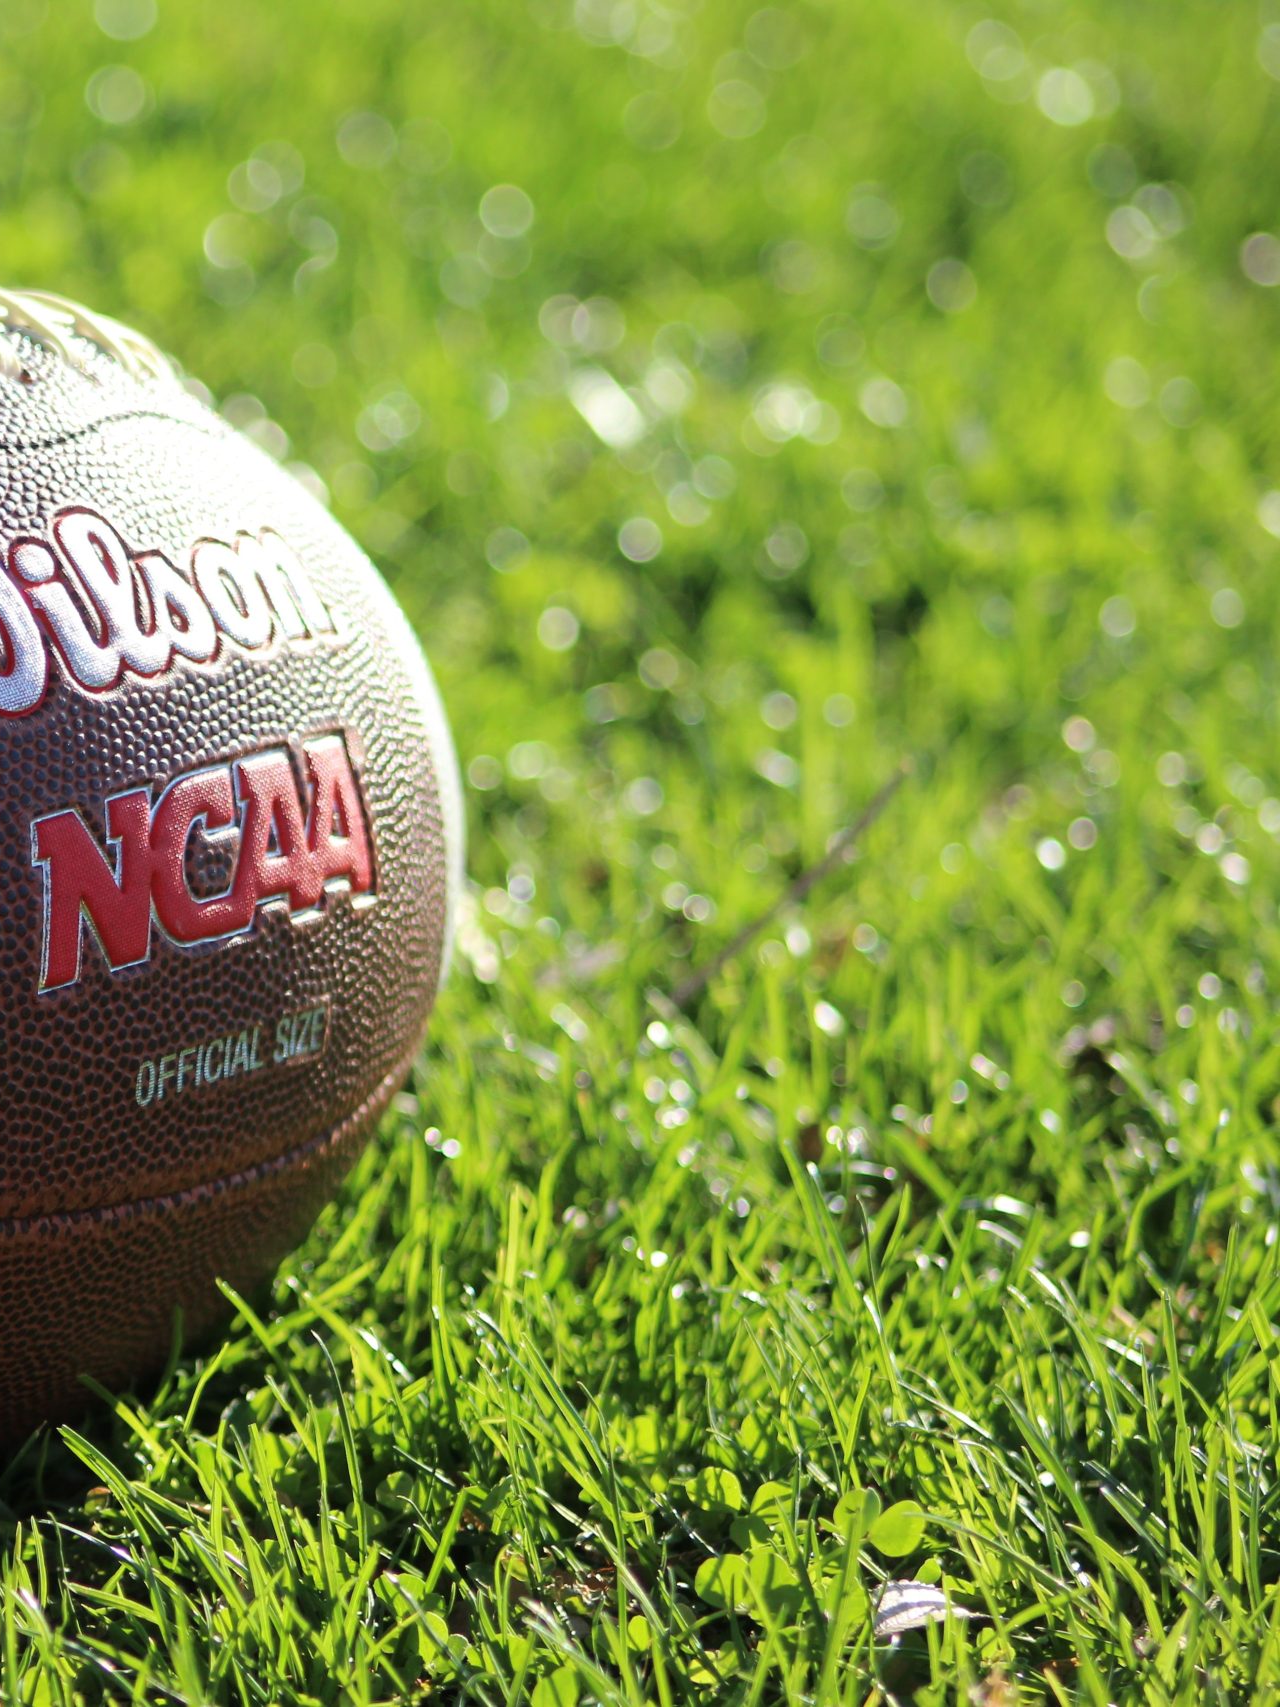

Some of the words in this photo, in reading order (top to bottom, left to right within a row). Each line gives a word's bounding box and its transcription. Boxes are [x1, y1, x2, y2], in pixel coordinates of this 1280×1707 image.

[30, 729, 377, 994] NCAA
[135, 1026, 264, 1107] OFFICIAL
[273, 1006, 326, 1063] SIZE
